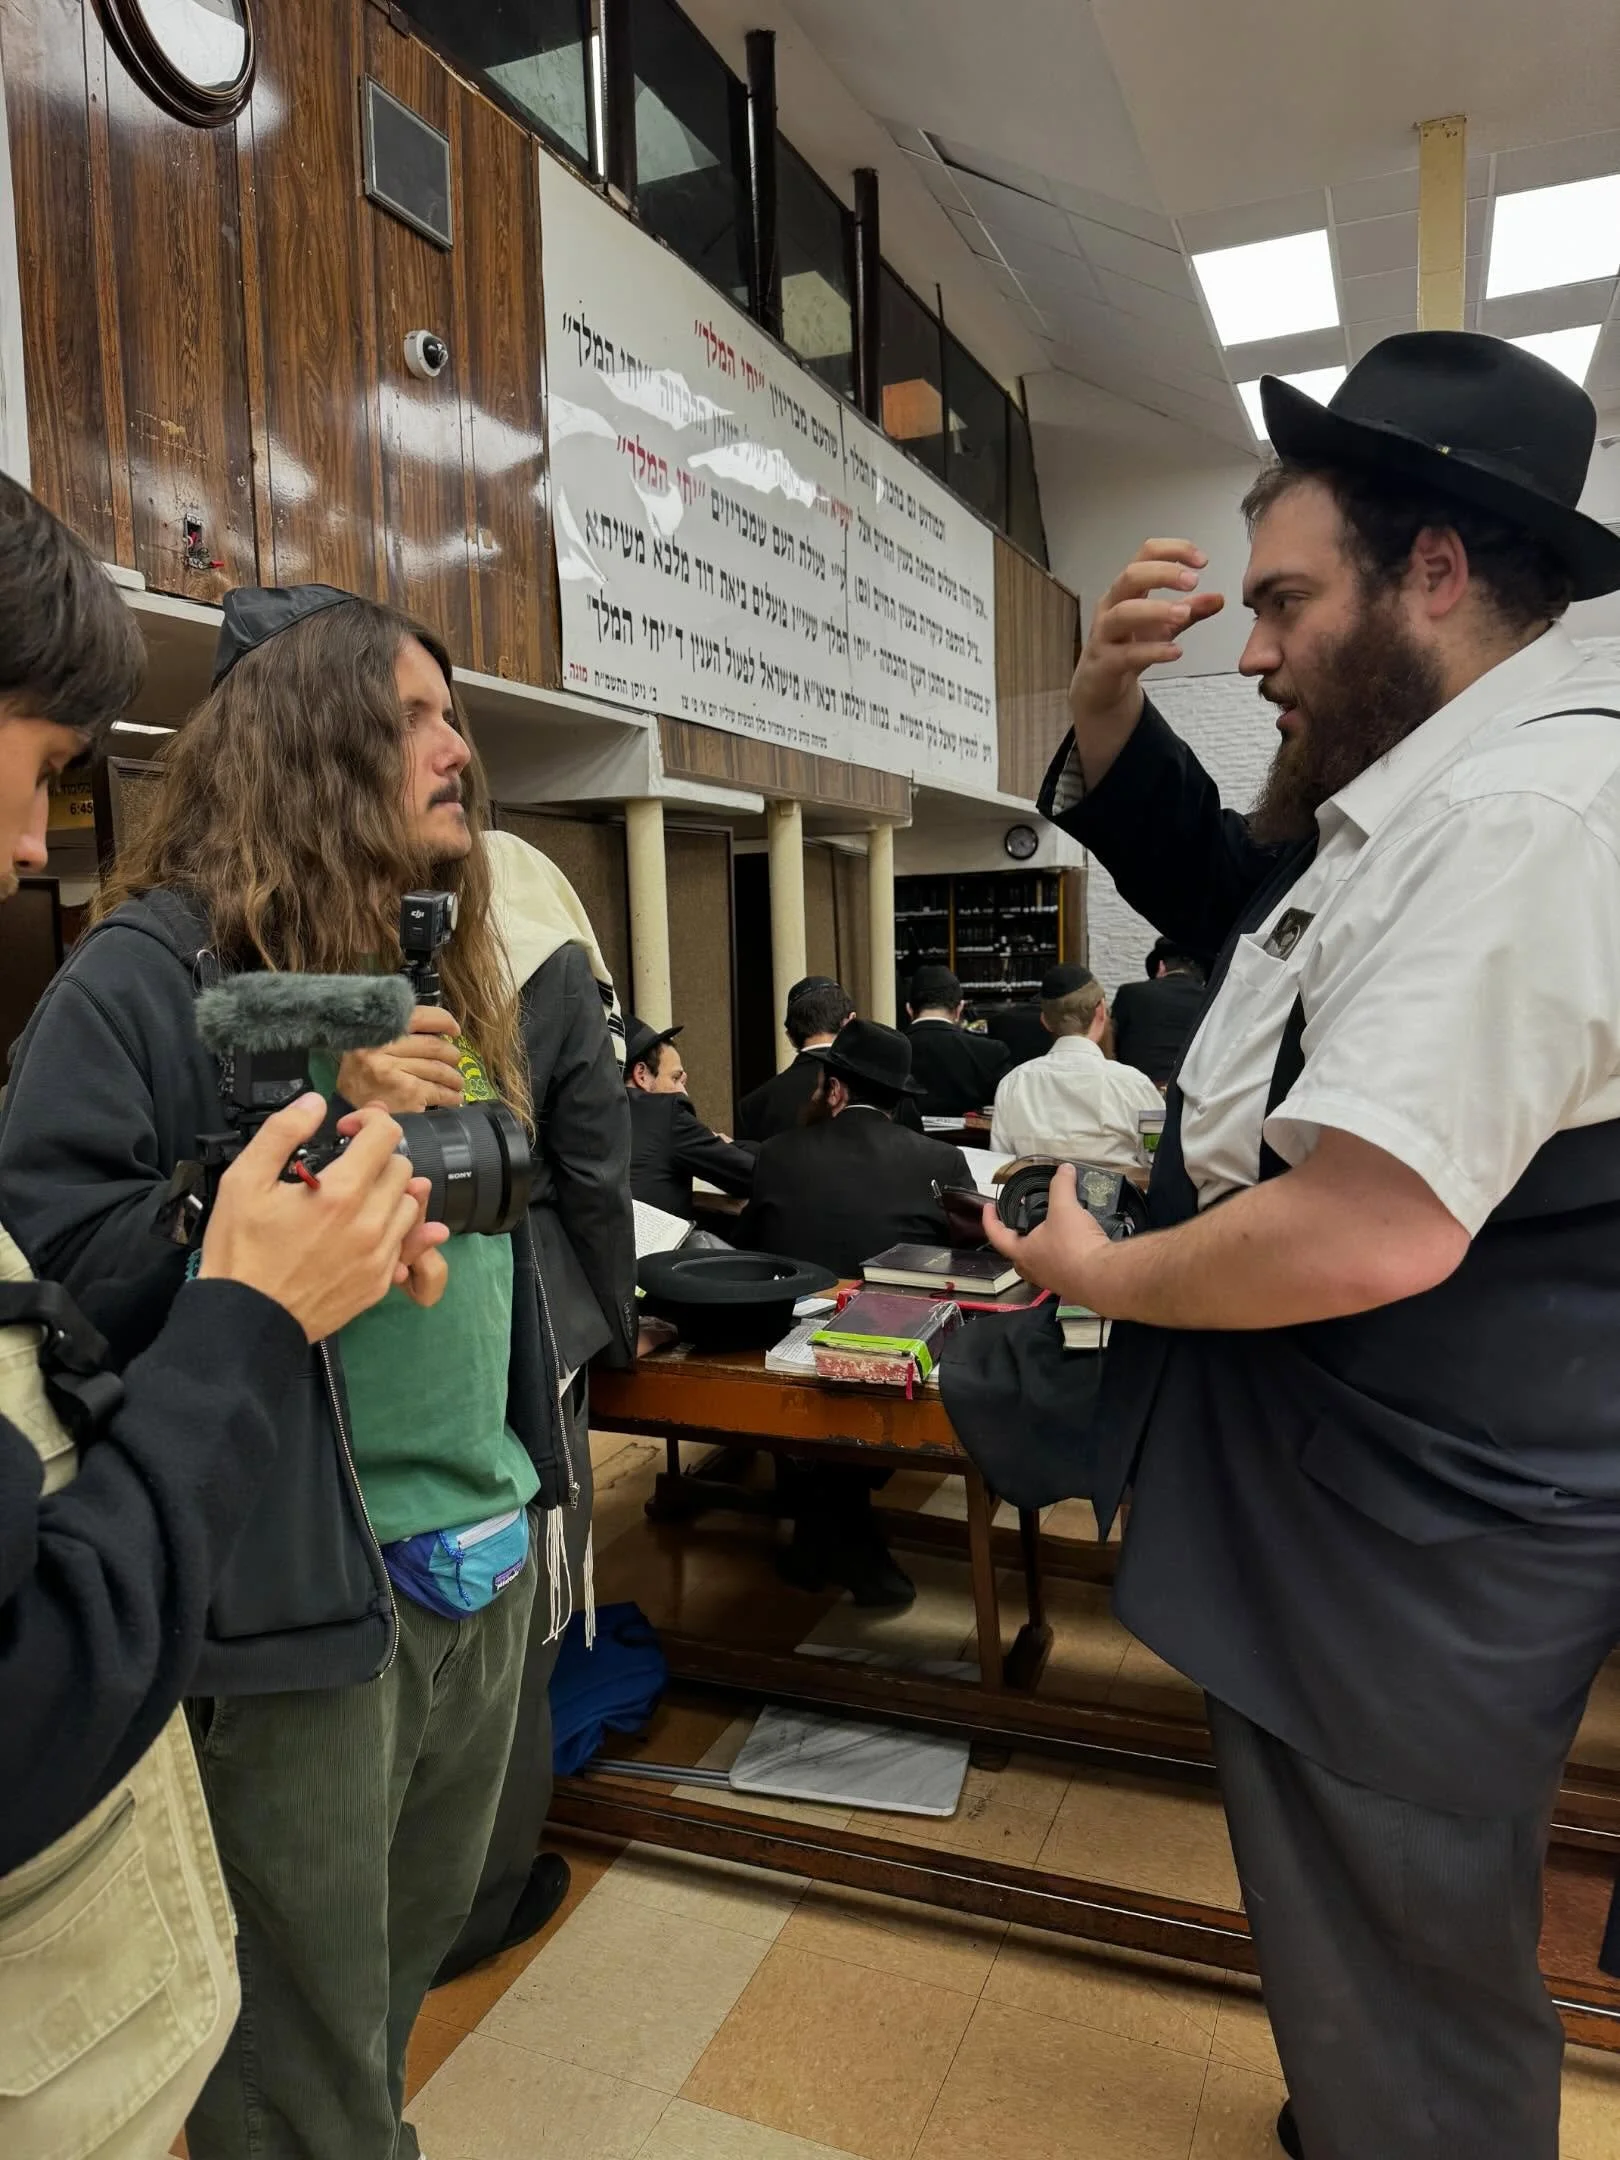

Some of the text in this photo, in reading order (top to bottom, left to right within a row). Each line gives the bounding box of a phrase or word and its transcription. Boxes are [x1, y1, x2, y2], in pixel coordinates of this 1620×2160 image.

[769, 381, 808, 436] מכריזין
[811, 414, 838, 459] שהעם
[710, 487, 767, 548] שמכריזים
[907, 492, 916, 520] גם
[585, 508, 646, 565] משיחא
[653, 533, 690, 584] מלכא
[772, 524, 795, 564] העם
[799, 535, 825, 581] פעולת
[695, 557, 714, 596] דוד
[719, 568, 747, 610] ביאת
[854, 575, 870, 609] (גם)
[752, 581, 787, 628] פועלים
[568, 661, 588, 684] מוגה
[690, 631, 721, 676] הענין
[724, 634, 756, 686] לפעול
[760, 650, 800, 702] מישראל
[630, 681, 646, 701] ניסן
[70, 802, 93, 816] 6:45
[447, 1171, 472, 1180] SONY
